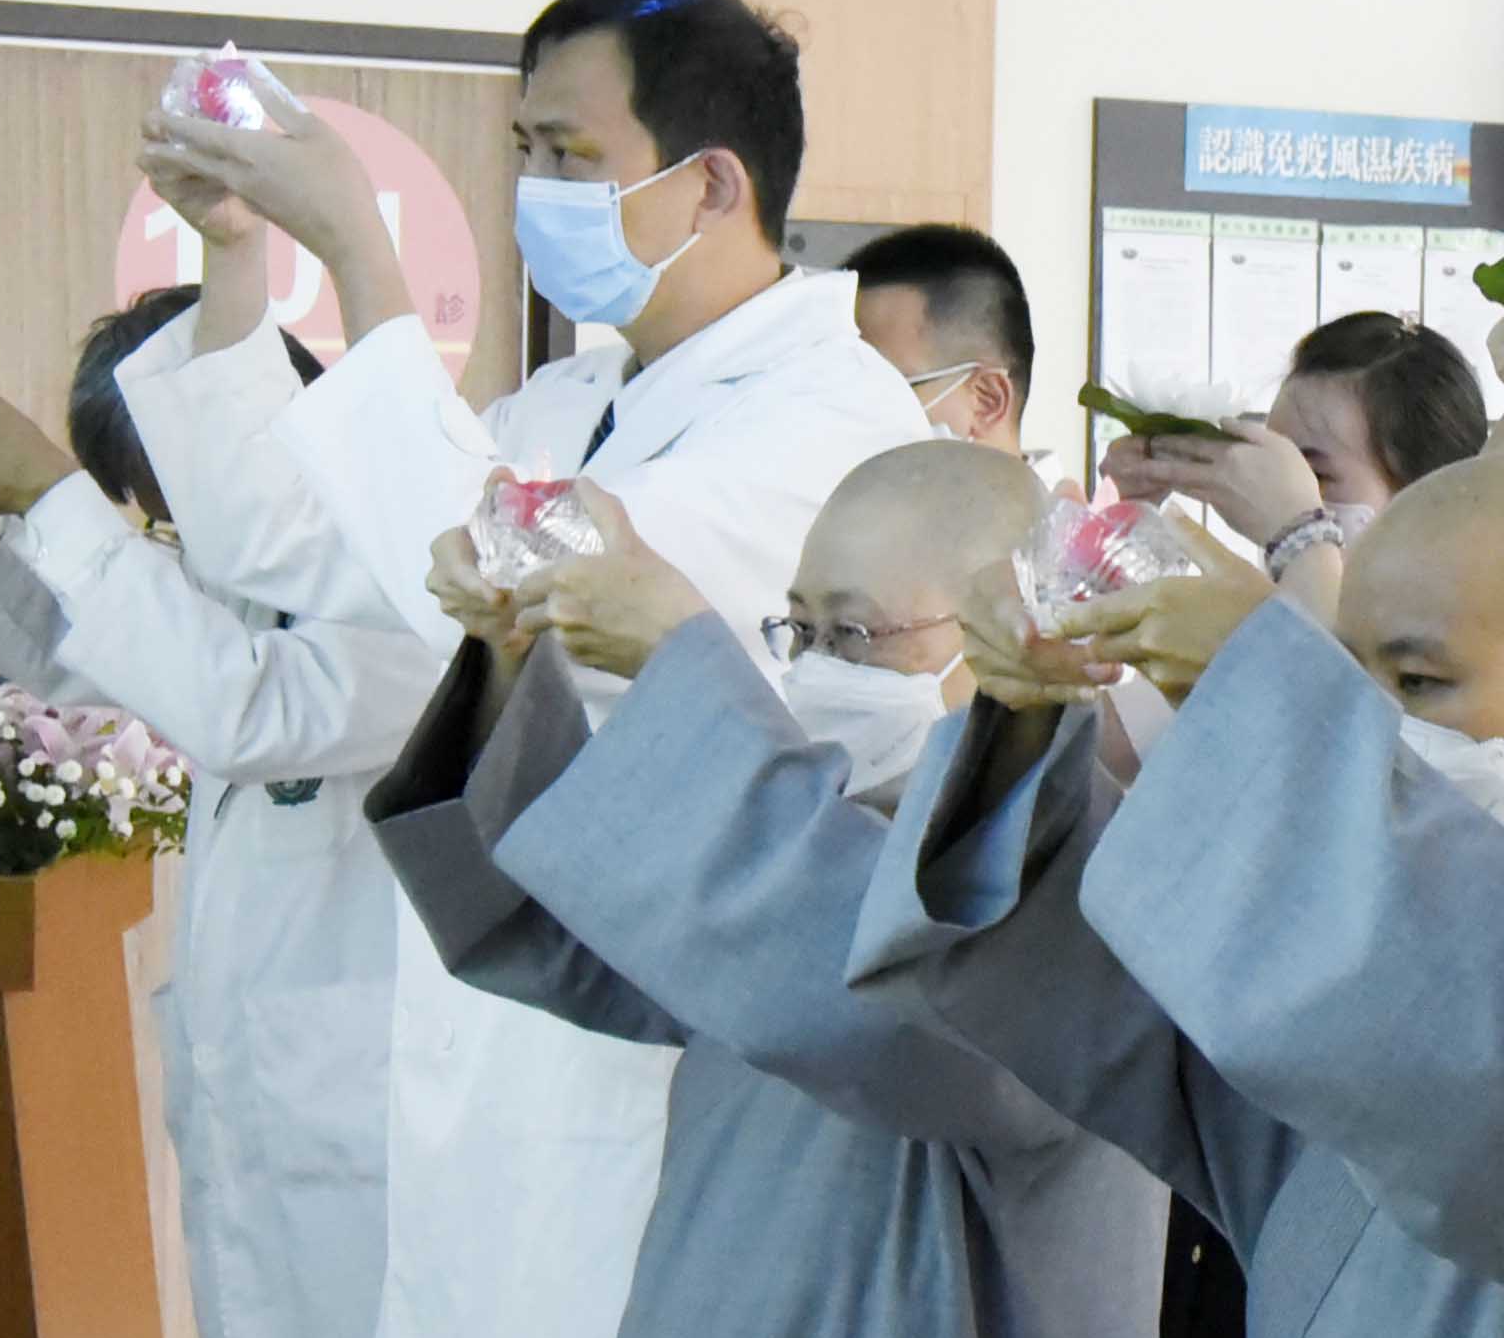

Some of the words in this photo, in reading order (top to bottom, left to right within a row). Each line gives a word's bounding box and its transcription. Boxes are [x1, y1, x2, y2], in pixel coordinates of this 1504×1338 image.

[1198, 126, 1456, 187] 認識免疫風濕疾病
